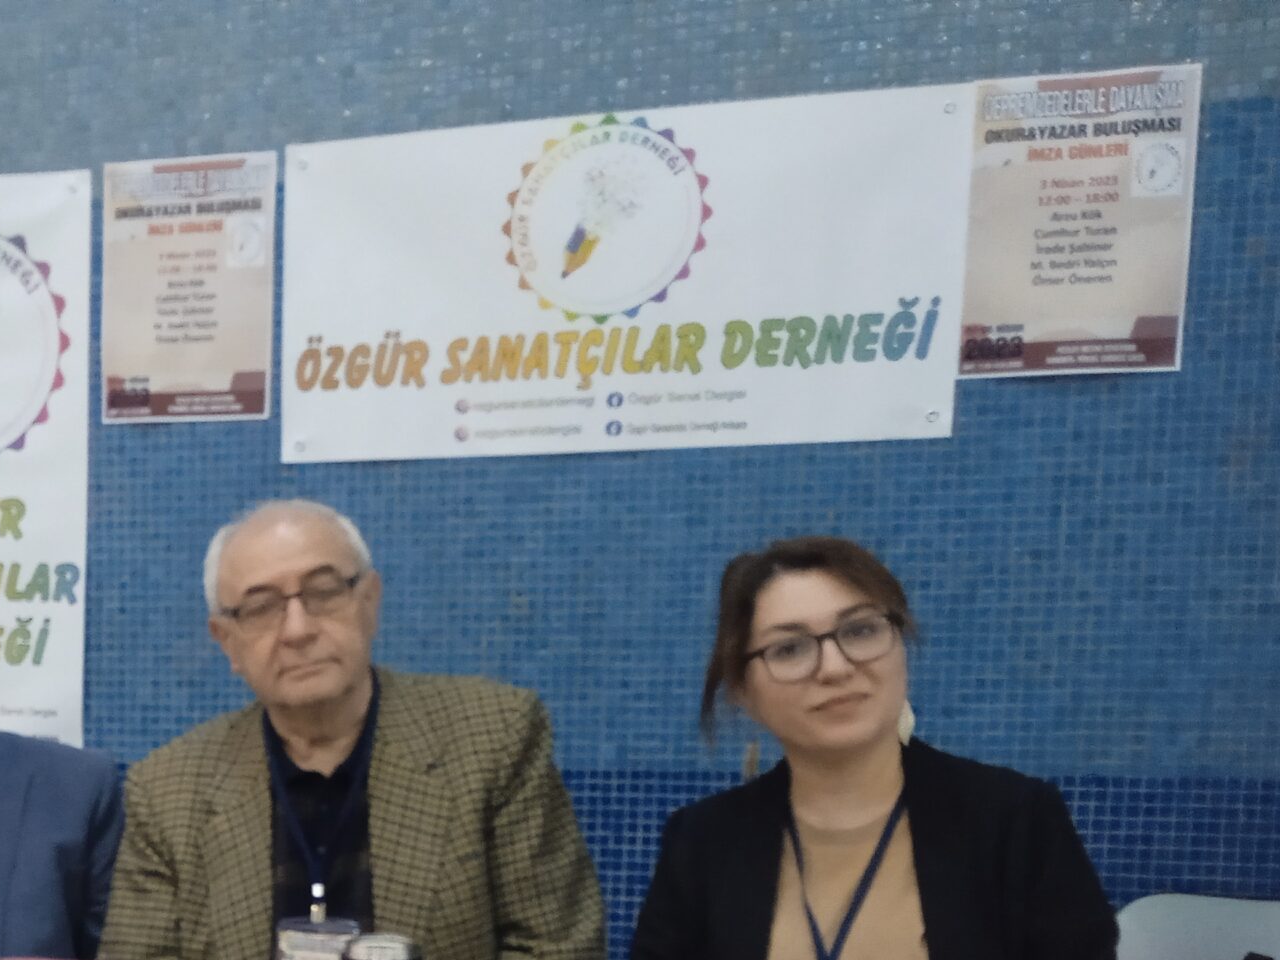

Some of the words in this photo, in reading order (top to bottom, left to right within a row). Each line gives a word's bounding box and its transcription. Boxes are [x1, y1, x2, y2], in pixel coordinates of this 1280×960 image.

[985, 123, 1087, 144] OKUR&YAZAR
[1093, 117, 1181, 137] BULUŞMASI
[296, 331, 430, 392] ÖZGÜR
[440, 321, 707, 391] SANATÇILAR
[720, 296, 942, 370] DERNEĞİ
